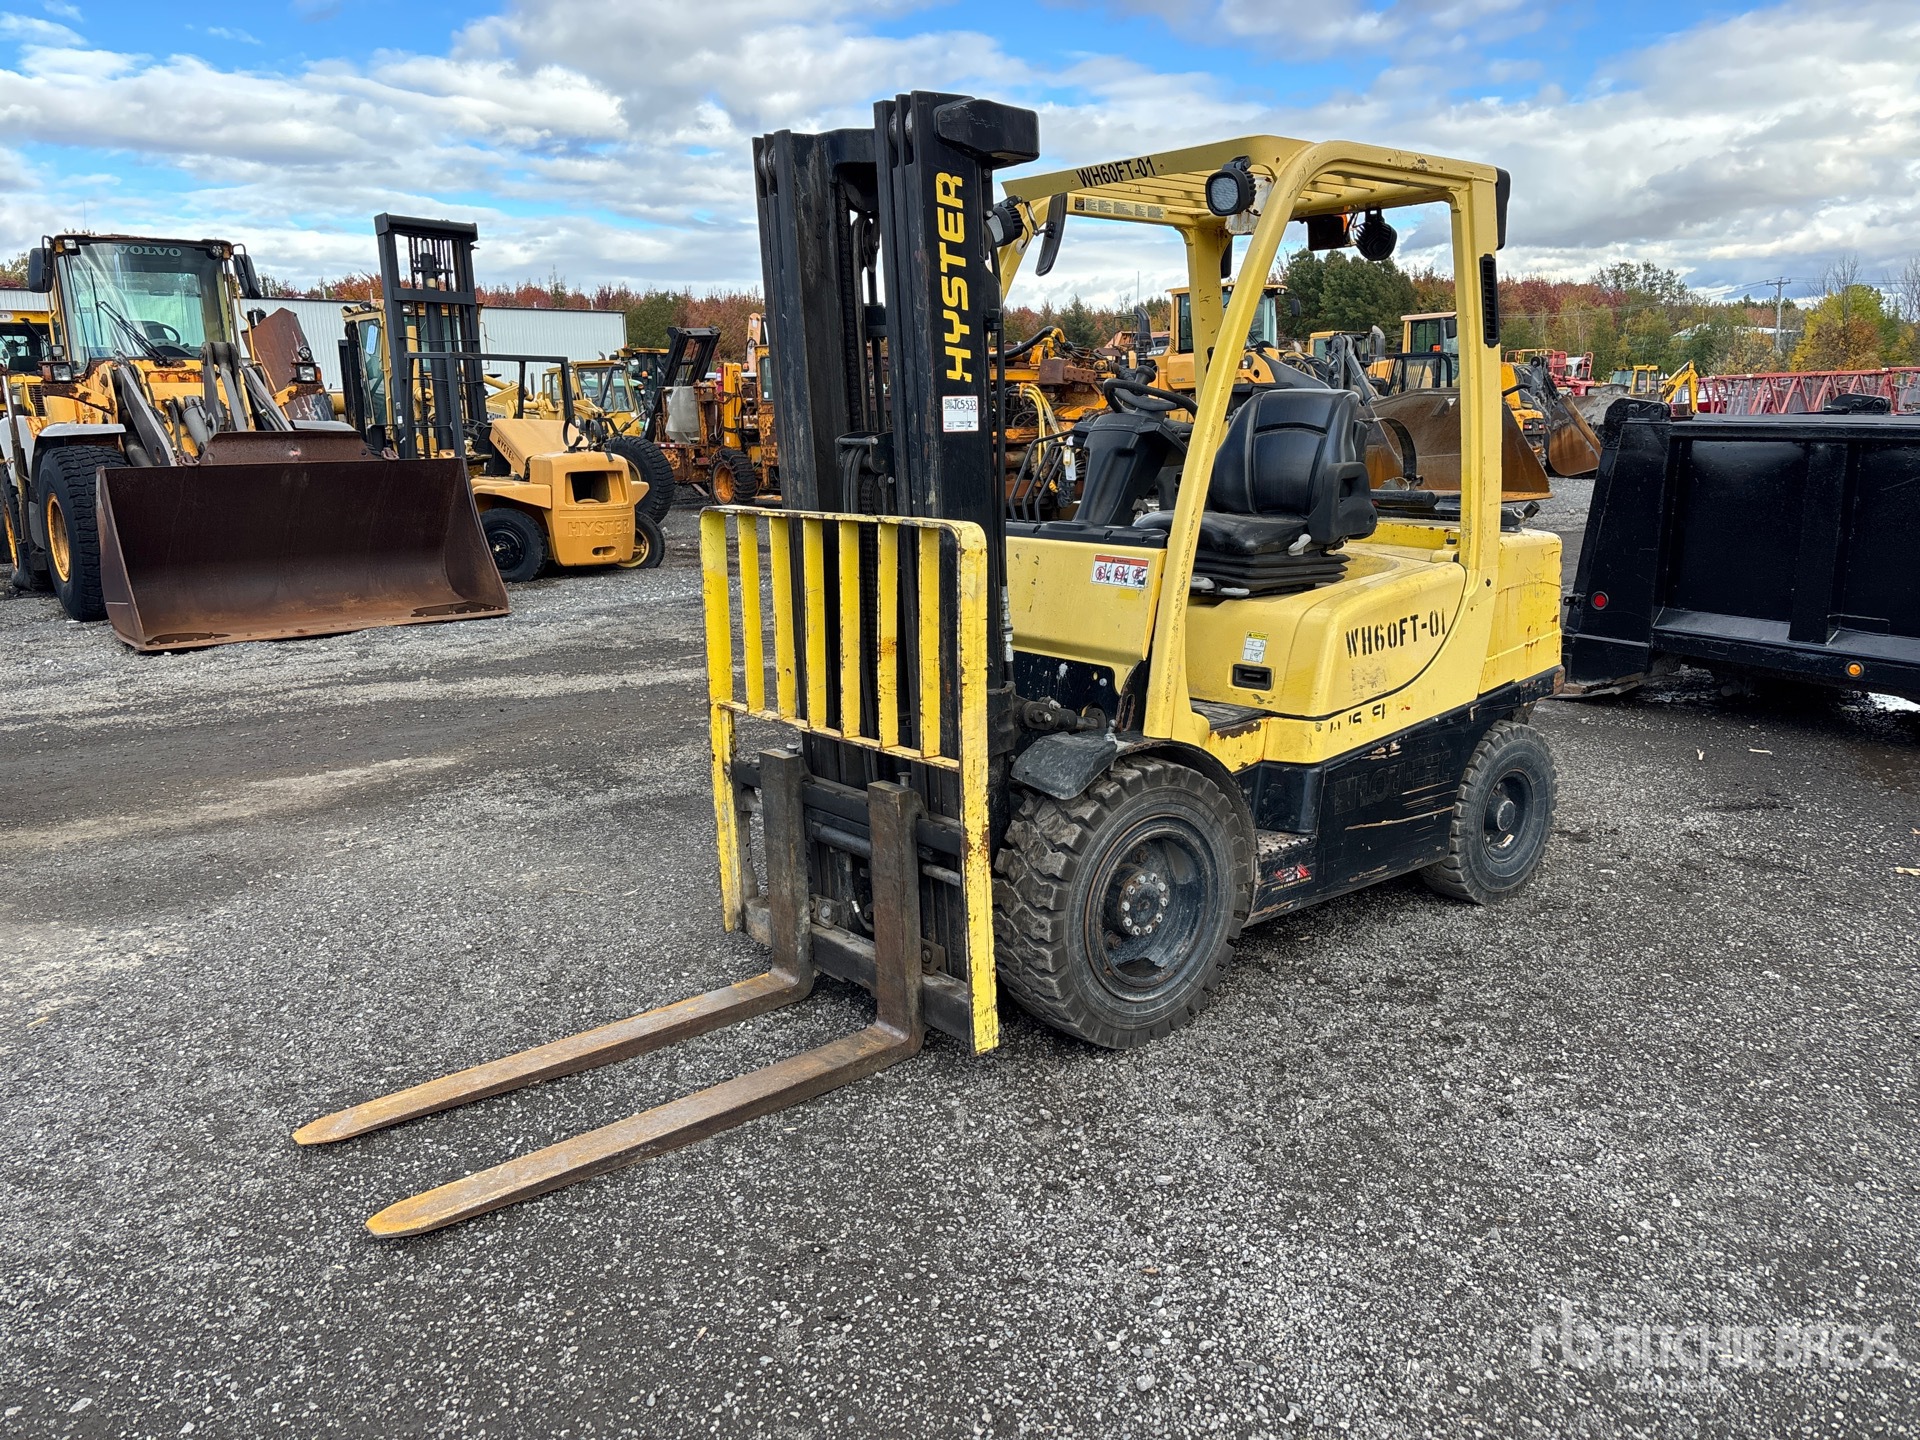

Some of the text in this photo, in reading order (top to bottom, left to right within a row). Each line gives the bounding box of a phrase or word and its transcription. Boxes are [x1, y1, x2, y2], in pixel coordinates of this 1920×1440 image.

[1076, 156, 1156, 188] WH60FT-01
[112, 245, 182, 257] VOLVO
[935, 172, 973, 383] HYSTER
[567, 518, 631, 537] HYSTER
[1345, 607, 1446, 659] WH60FT-01
